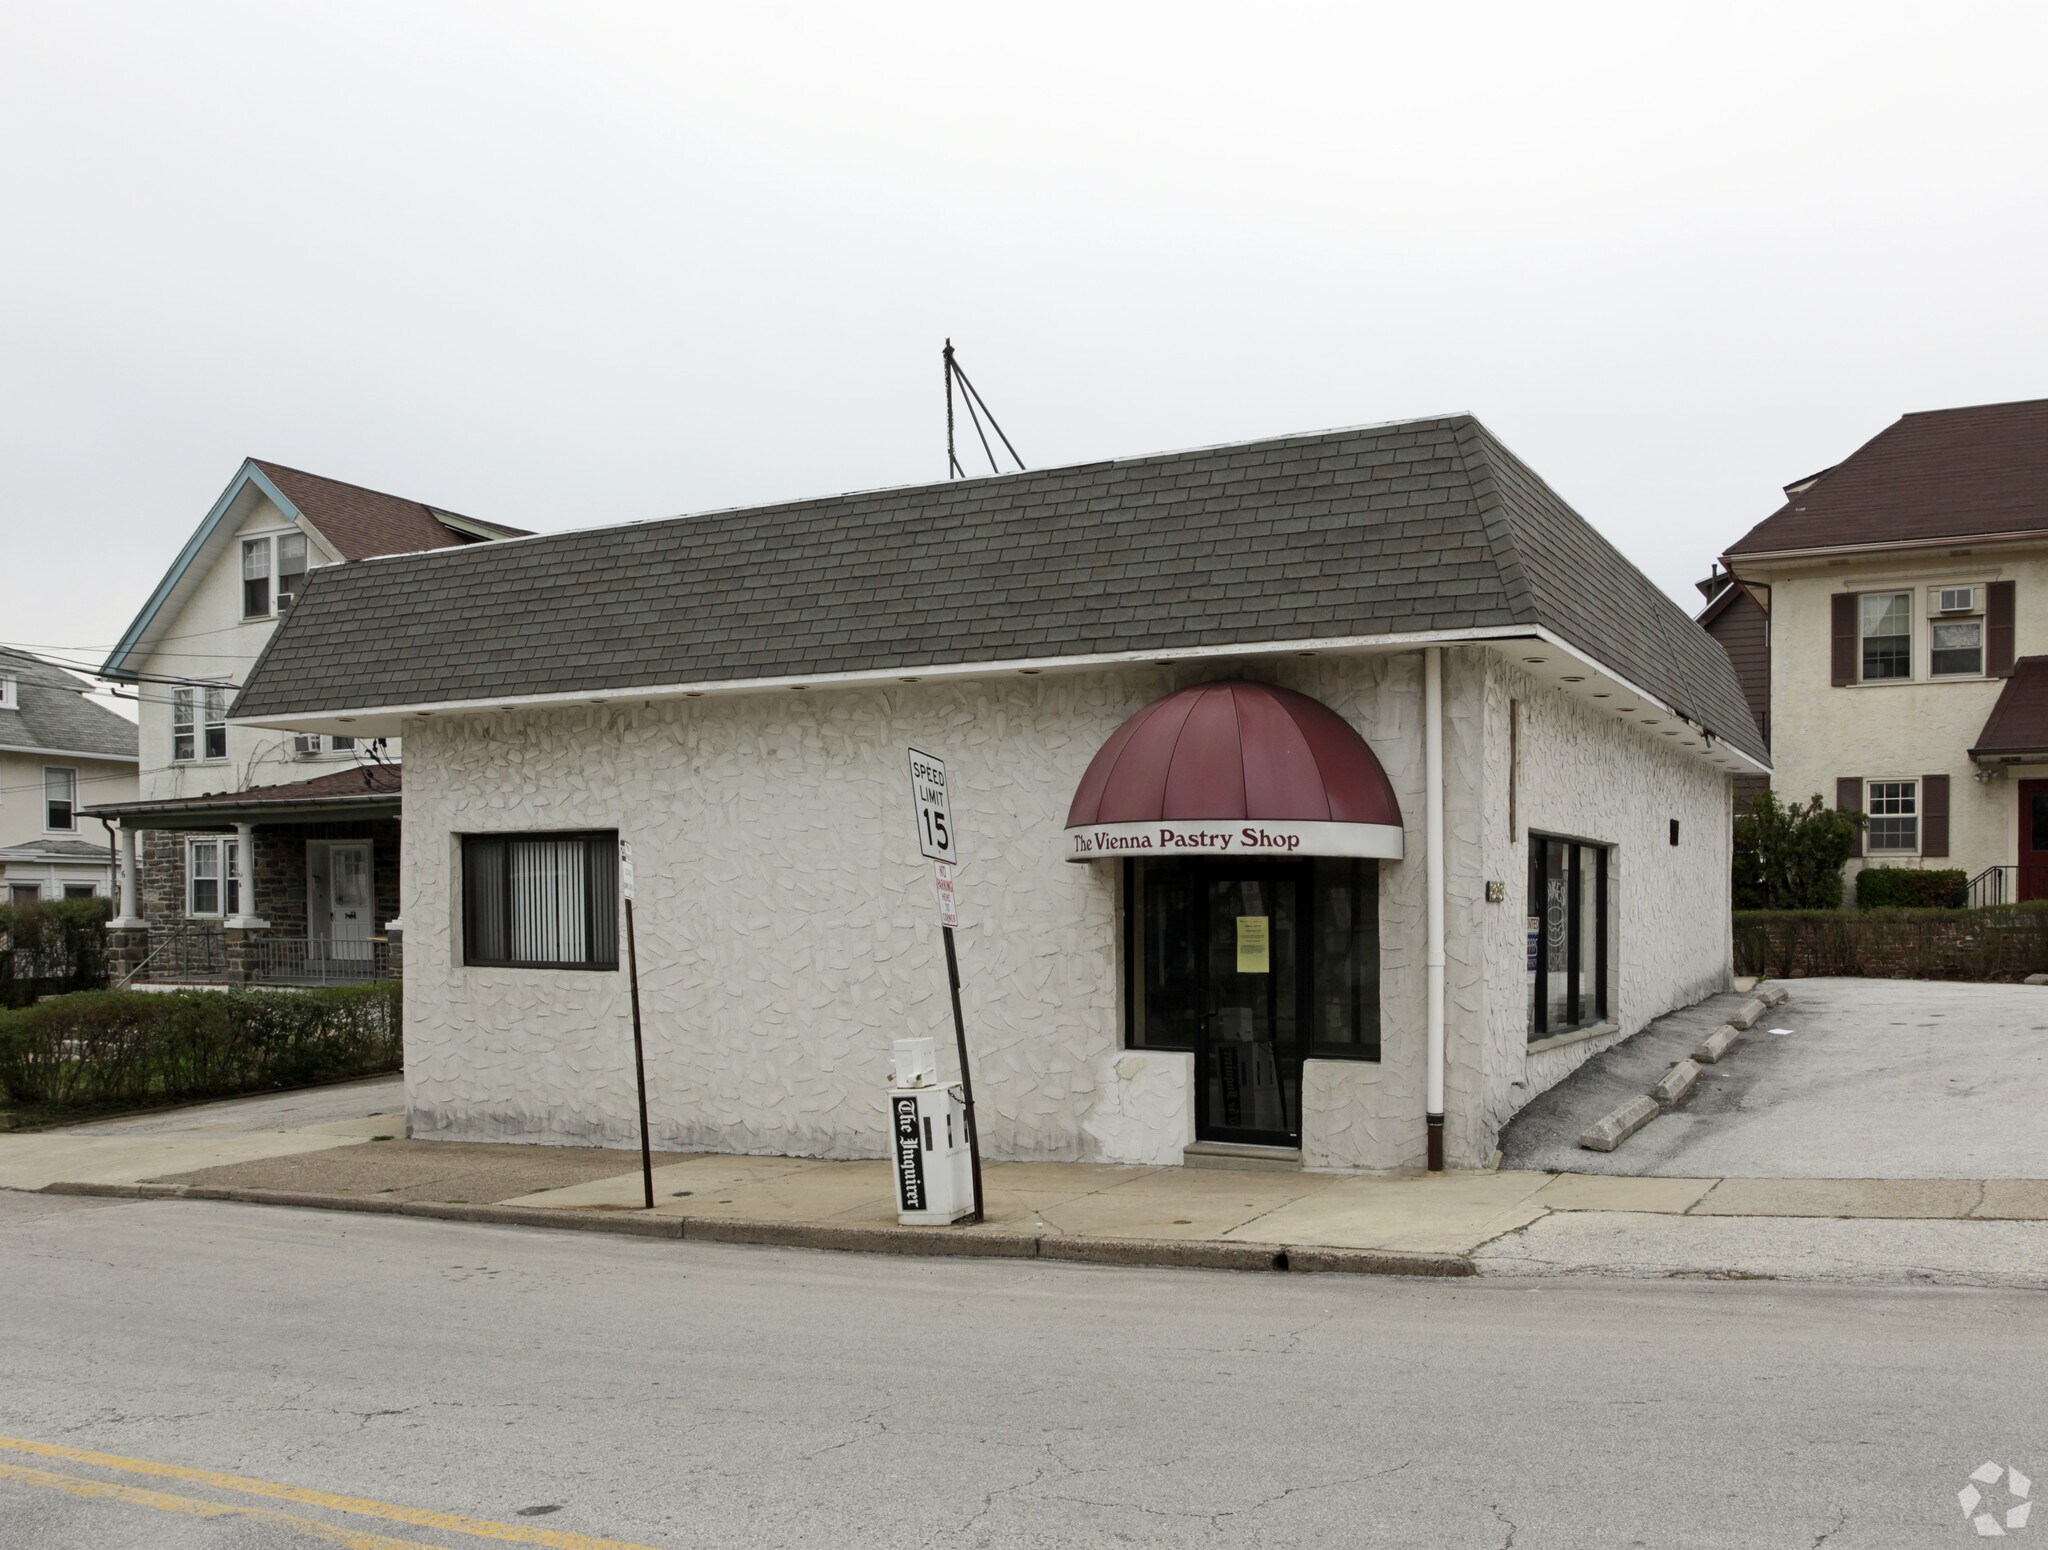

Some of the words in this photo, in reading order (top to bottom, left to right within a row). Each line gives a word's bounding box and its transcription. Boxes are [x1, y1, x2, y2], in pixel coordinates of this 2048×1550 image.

[913, 762, 945, 787] SPEED
[919, 785, 944, 808] LIMIT
[923, 808, 949, 850] 15
[1073, 834, 1093, 852] The
[1095, 832, 1152, 851] Vienna
[1159, 829, 1234, 850] Pastry
[1240, 828, 1300, 852] Shop
[897, 1100, 917, 1133] The
[899, 1137, 921, 1208] Inquirer
